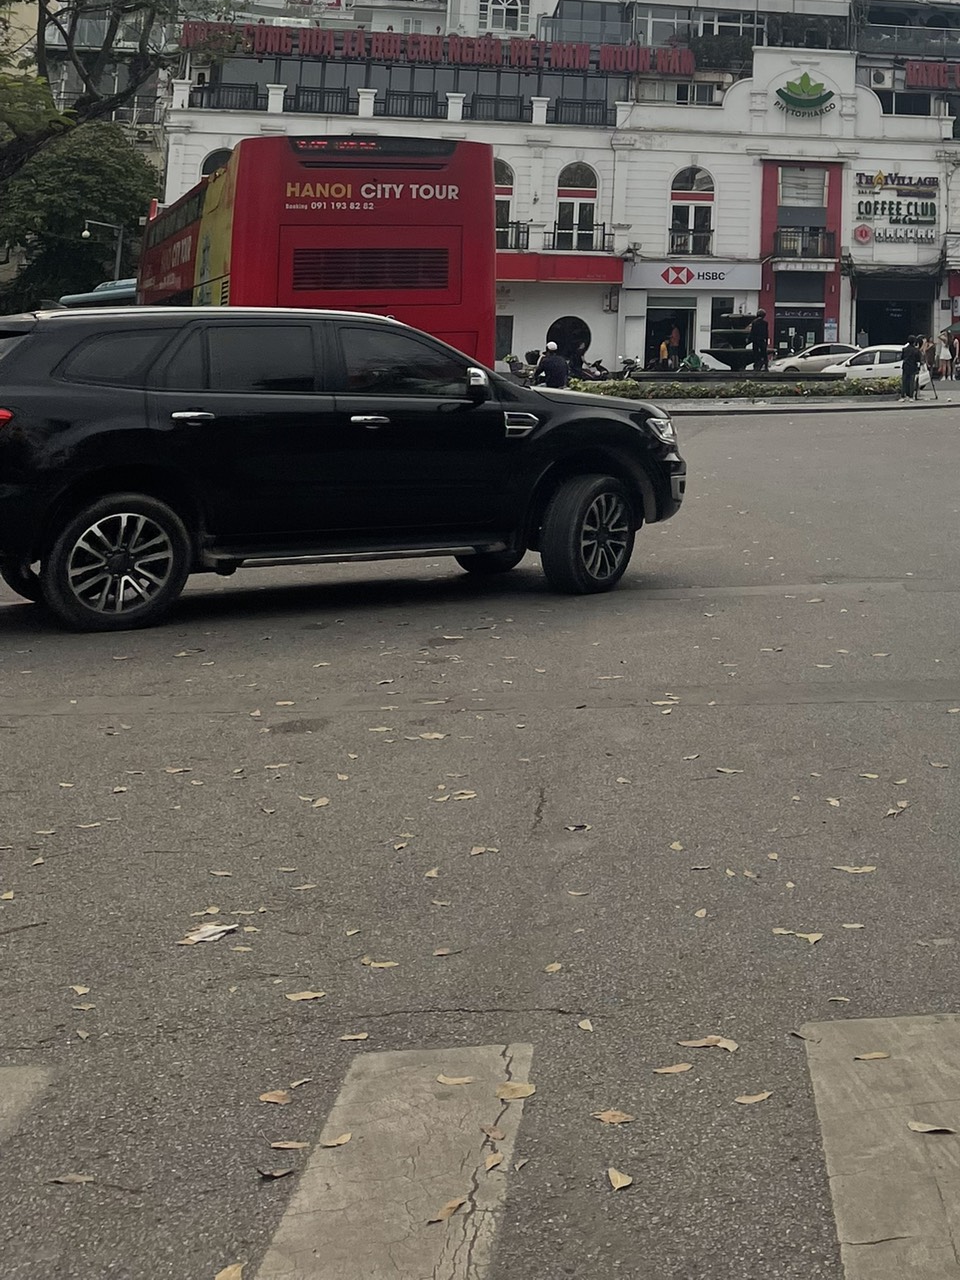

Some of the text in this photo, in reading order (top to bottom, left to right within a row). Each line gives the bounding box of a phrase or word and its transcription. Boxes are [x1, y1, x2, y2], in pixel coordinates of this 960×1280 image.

[550, 41, 591, 70] NAM
[774, 100, 836, 118] PHYTOPHARCO
[286, 182, 459, 200] HANOI CITY TOUR
[310, 202, 327, 210] 091
[330, 202, 347, 210] 193
[349, 202, 361, 210] 82
[362, 202, 374, 210] 82
[857, 201, 936, 216] COFFEE CLUB
[697, 272, 726, 281] HSBC
